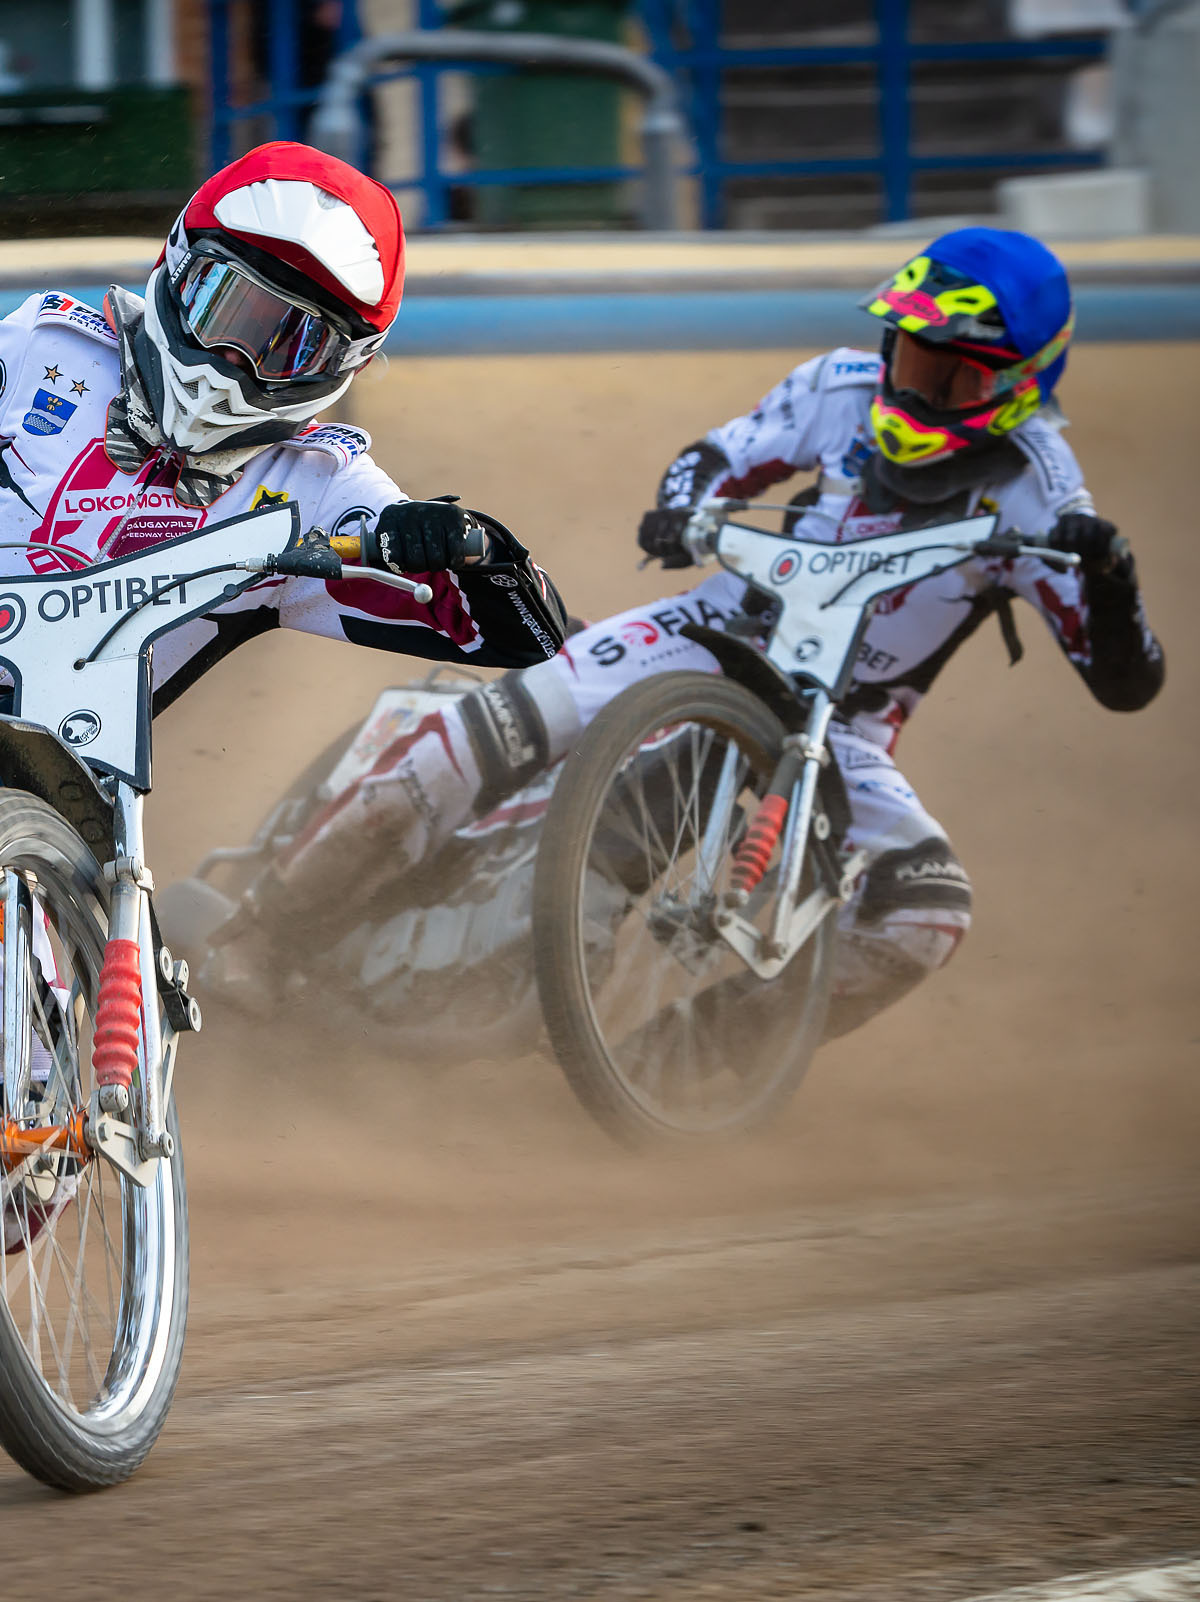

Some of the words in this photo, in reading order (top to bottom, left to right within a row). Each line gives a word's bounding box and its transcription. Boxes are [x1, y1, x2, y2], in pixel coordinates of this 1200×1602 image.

[171, 252, 192, 285] OAKLEY
[319, 426, 367, 454] PAR
[64, 493, 190, 514] LOKOMOTI
[126, 521, 194, 531] DAUGAVPILS
[808, 551, 914, 576] OPTIBET
[37, 573, 193, 623] OPTIBET
